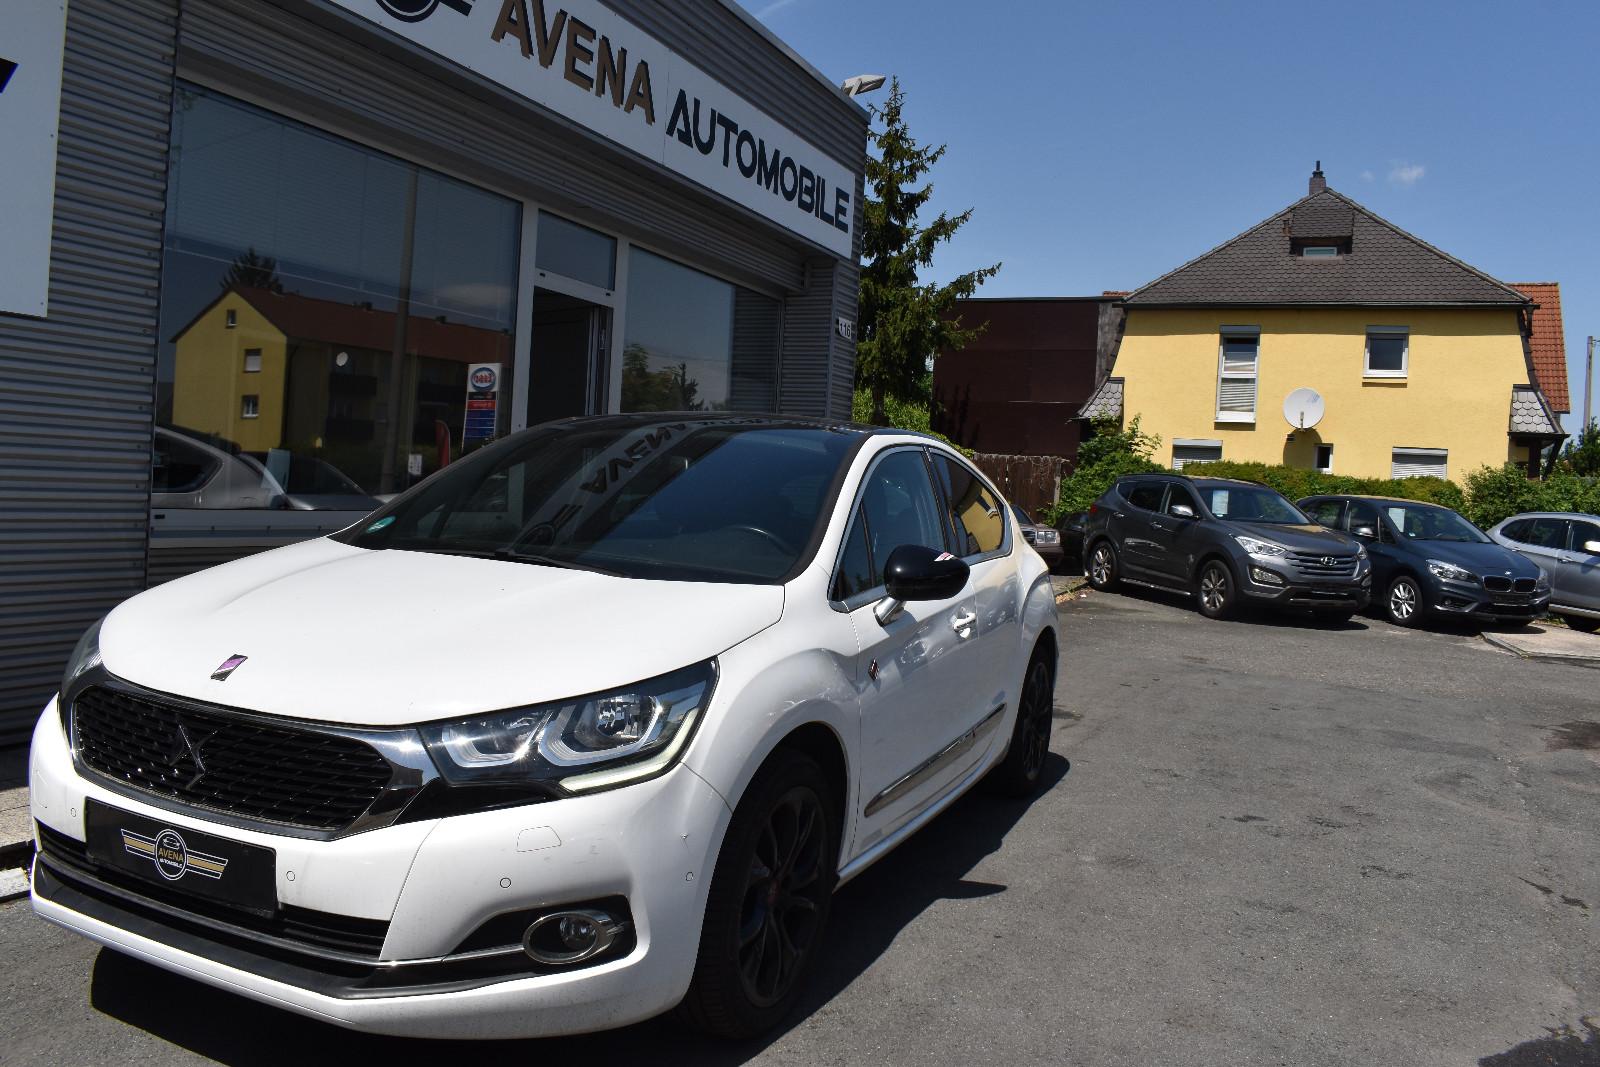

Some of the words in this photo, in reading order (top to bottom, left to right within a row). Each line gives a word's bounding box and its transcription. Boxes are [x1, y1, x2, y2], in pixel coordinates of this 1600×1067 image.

[491, 0, 655, 126] AVENA
[666, 88, 849, 234] AUTOMOBILE
[158, 847, 184, 862] AVENA
